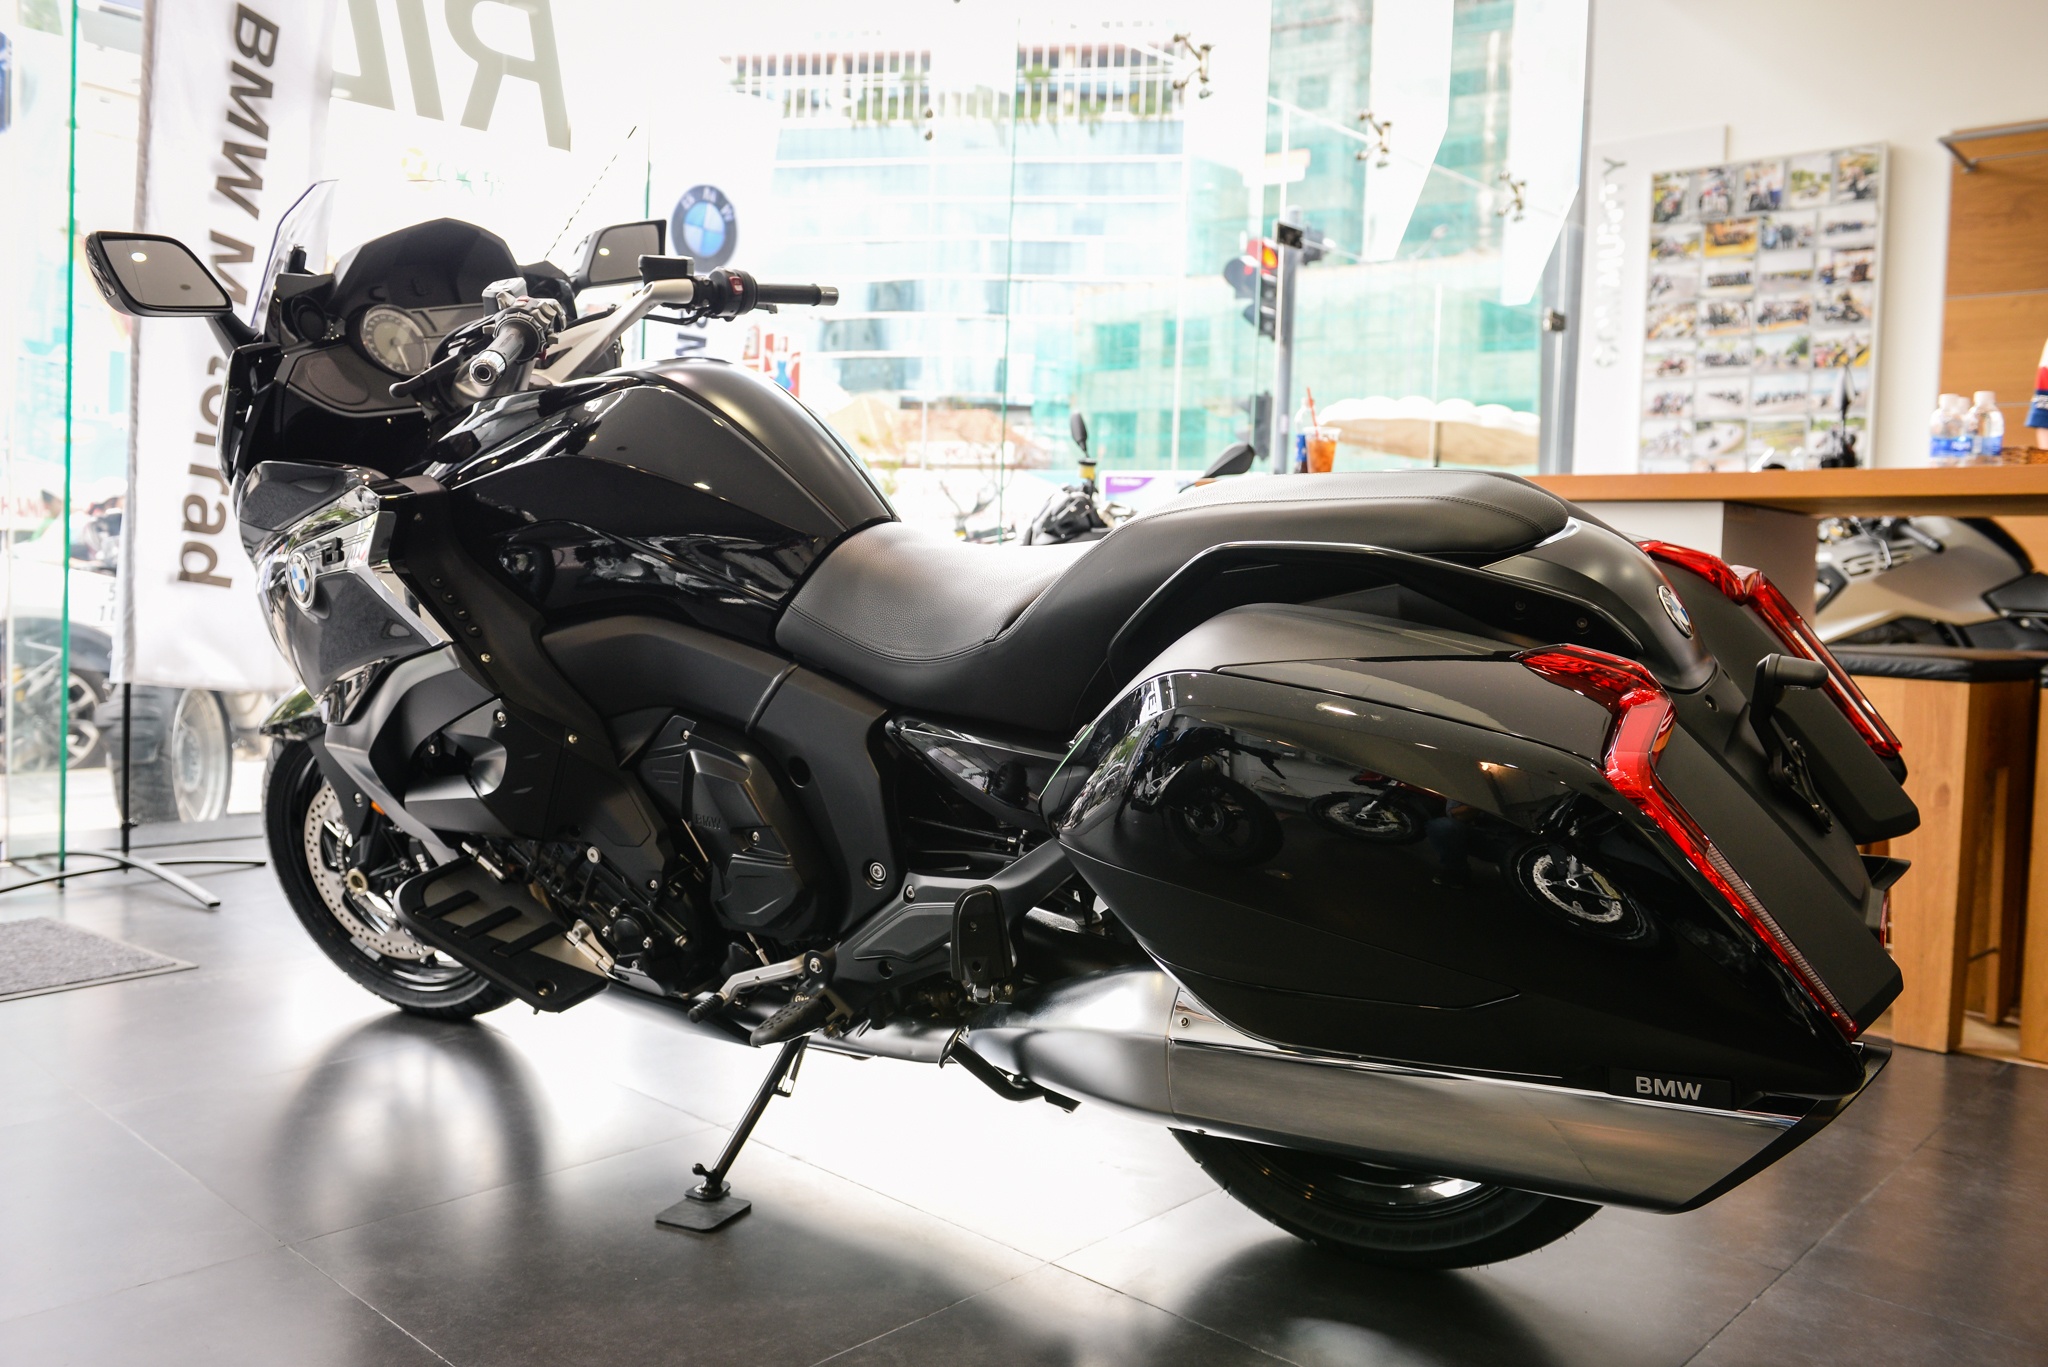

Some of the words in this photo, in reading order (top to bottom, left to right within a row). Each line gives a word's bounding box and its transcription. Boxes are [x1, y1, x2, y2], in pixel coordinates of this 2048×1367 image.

[215, 3, 280, 221] BMW
[177, 229, 256, 589] Morad
[695, 813, 721, 830] BMW
[1635, 1075, 1702, 1101] BMW
